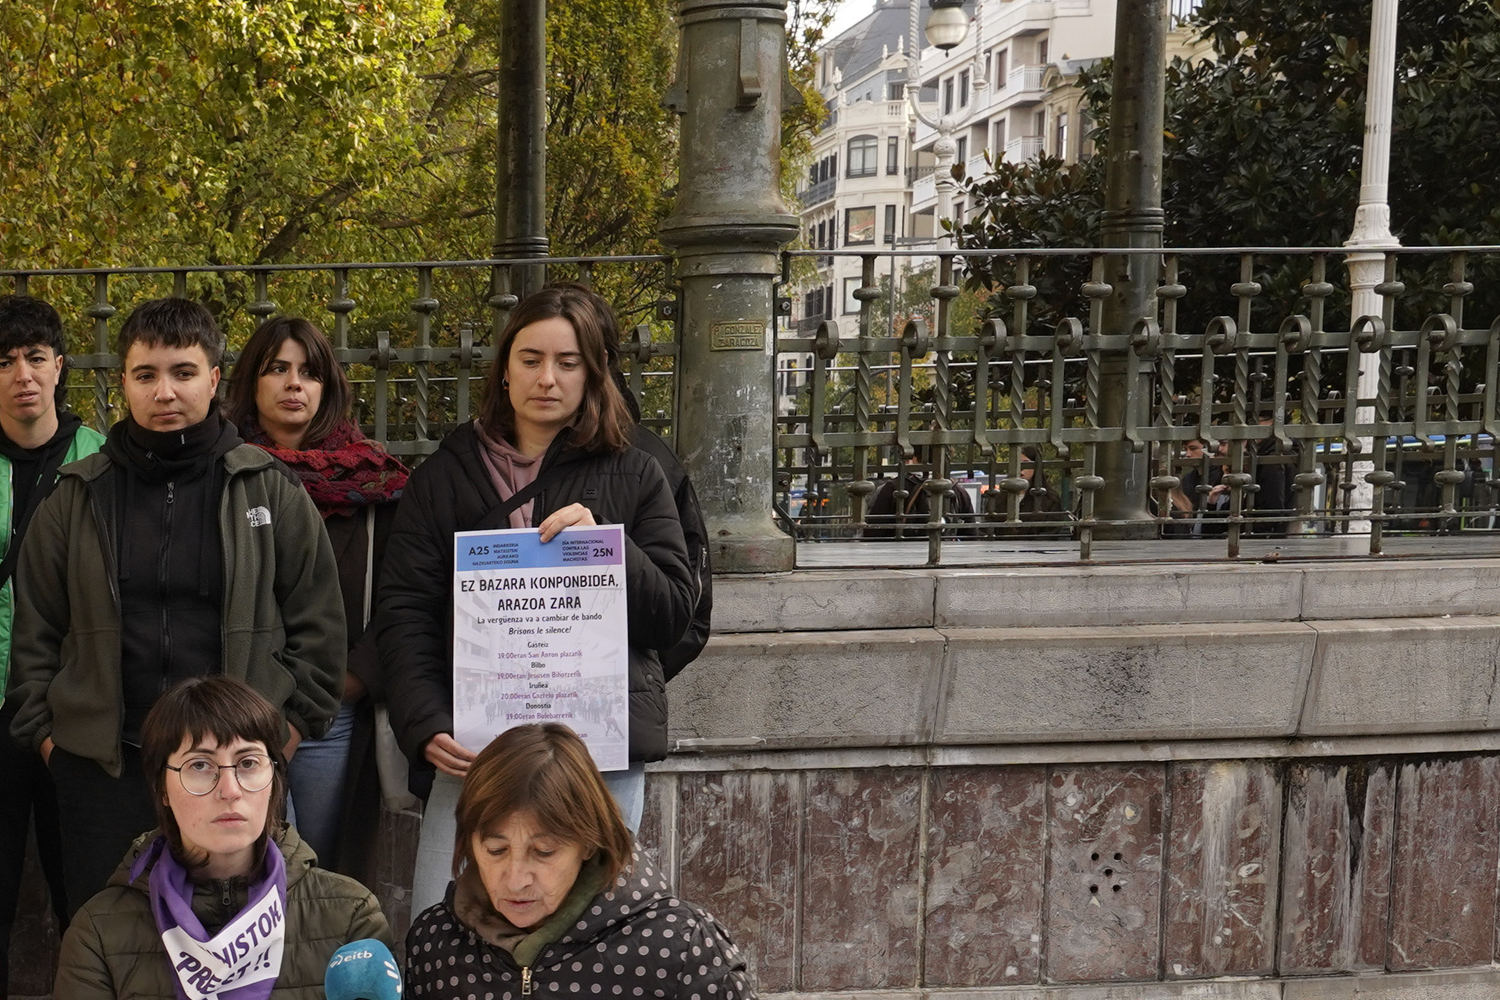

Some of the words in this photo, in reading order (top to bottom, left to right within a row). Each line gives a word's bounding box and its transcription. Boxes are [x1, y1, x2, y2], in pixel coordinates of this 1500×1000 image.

[725, 325, 762, 335] GONZALEZ
[719, 338, 760, 348] ZARAGOZA
[468, 546, 489, 556] A25
[593, 548, 613, 557] 25N
[461, 580, 475, 592] EZ
[479, 578, 526, 591] BAZARA
[530, 574, 618, 589] KONPONBIDEA,
[497, 598, 546, 611] ARAZOA
[550, 596, 581, 609] ZARA
[487, 615, 523, 625] vergüenza
[542, 614, 568, 622] cambiar
[508, 627, 535, 635] Brisons
[545, 626, 572, 634] silence!
[344, 950, 373, 962] eitb
